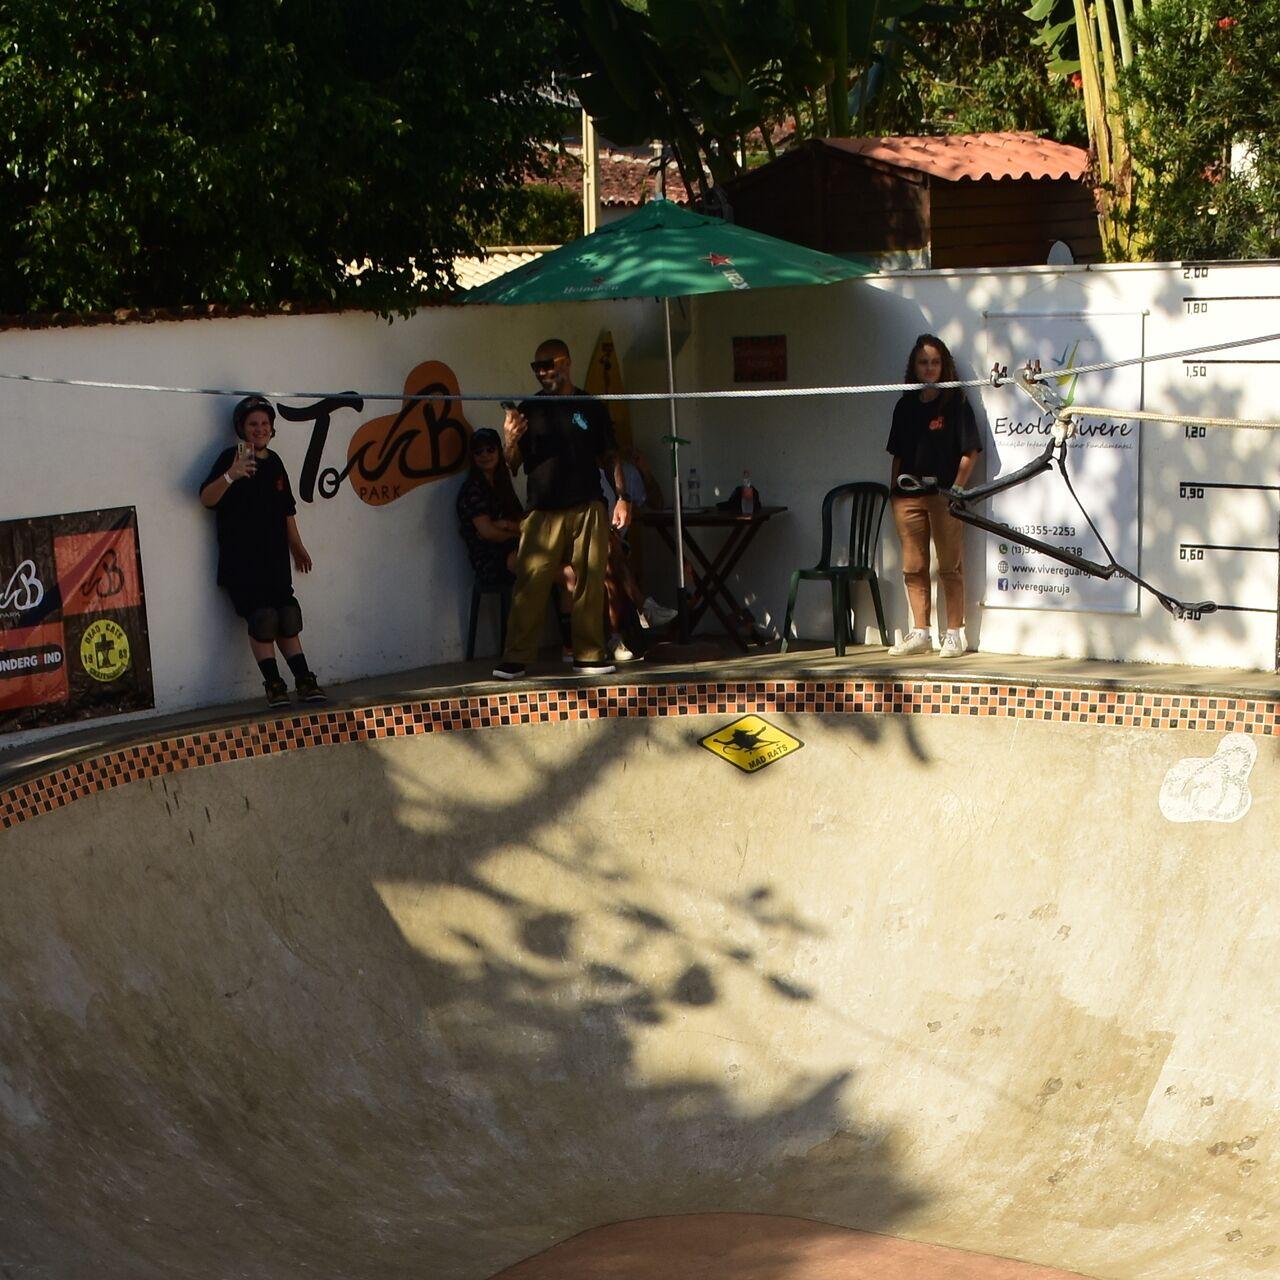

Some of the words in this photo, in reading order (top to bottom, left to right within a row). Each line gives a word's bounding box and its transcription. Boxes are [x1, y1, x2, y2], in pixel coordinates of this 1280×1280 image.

[1187, 302, 1207, 315] 1,80
[1186, 366, 1207, 379] 1,50
[1074, 417, 1133, 437] ivere
[1185, 426, 1206, 439] 1,20
[360, 485, 401, 500] PARK
[1180, 488, 1204, 500] 0,90
[1180, 549, 1204, 562] 0,60
[1012, 581, 1070, 595] vivereguaruja
[748, 756, 767, 769] MAD
[767, 744, 788, 760] RATS
